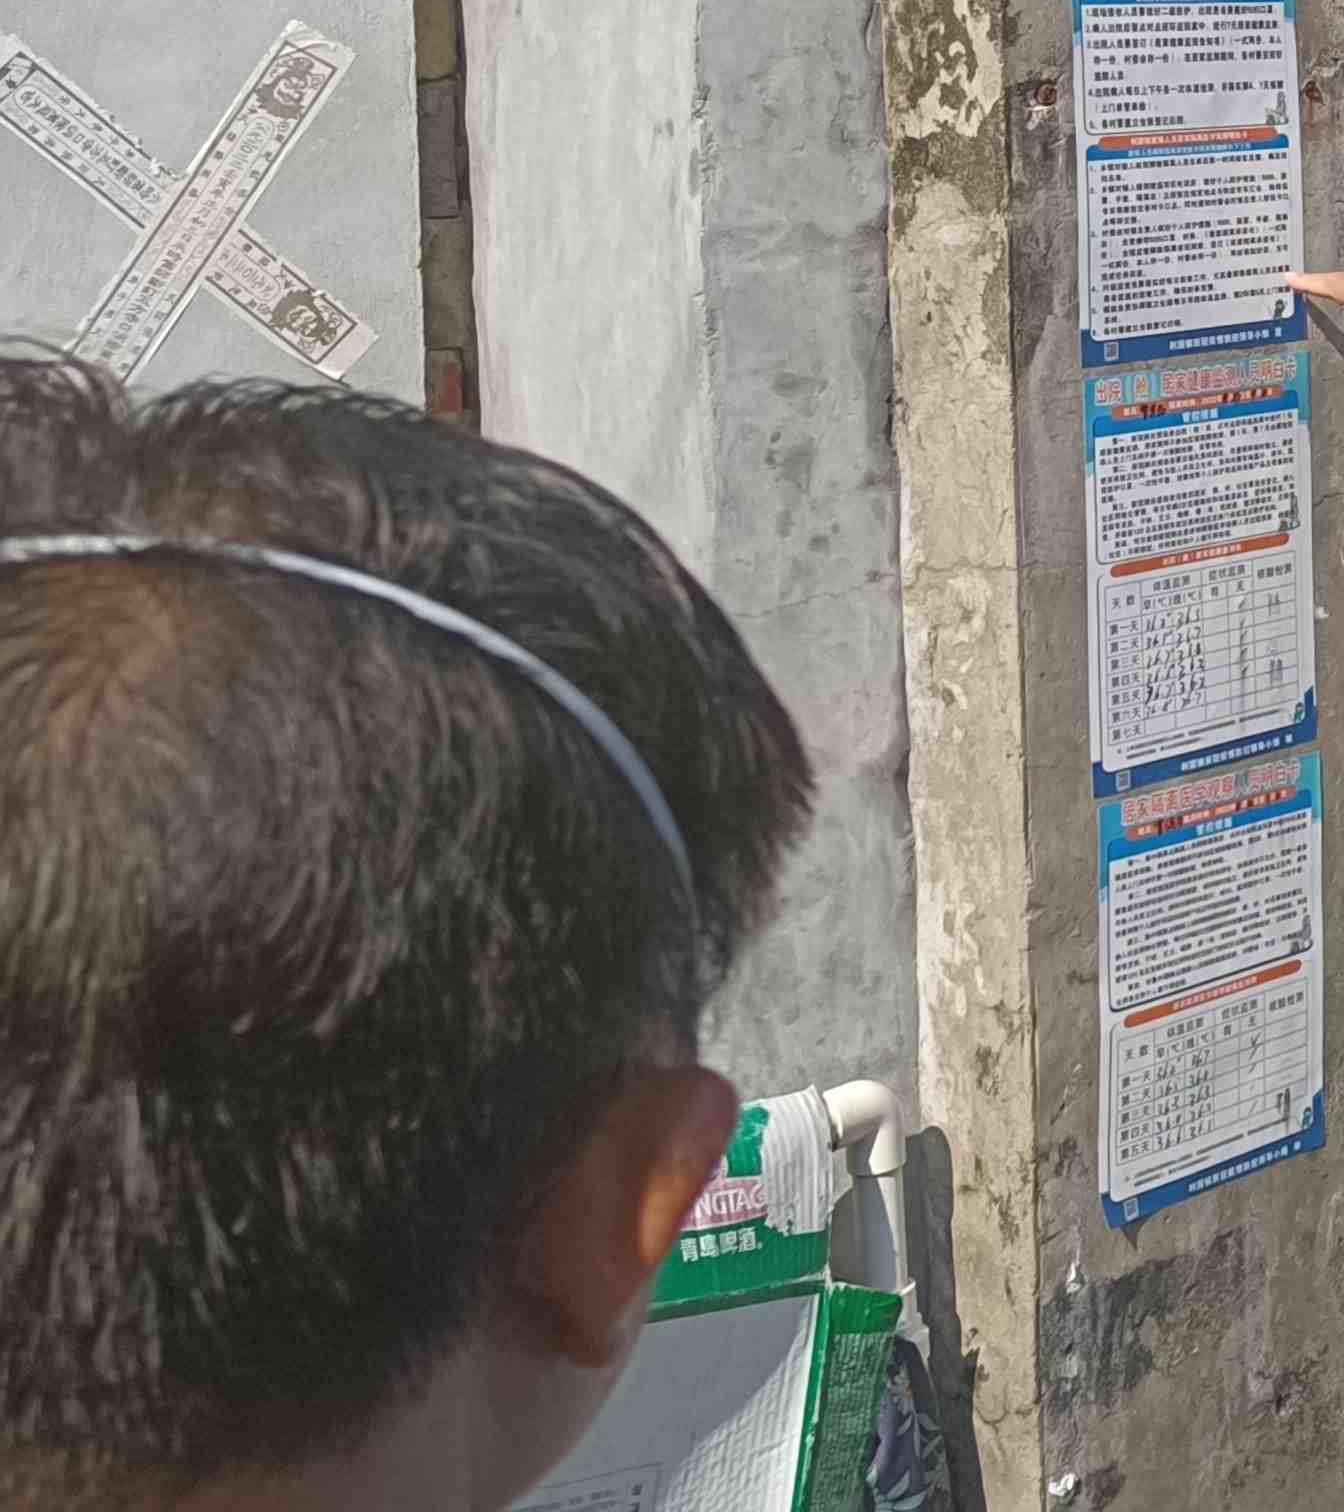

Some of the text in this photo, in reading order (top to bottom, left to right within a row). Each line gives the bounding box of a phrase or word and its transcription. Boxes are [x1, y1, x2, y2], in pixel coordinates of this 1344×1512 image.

[1109, 620, 1139, 636] 第一天
[1110, 637, 1140, 652] 第二天
[1110, 655, 1141, 670] 第三天
[1111, 672, 1141, 687] 第四天
[1111, 707, 1142, 723] 第六天
[1112, 724, 1143, 740] 第七天
